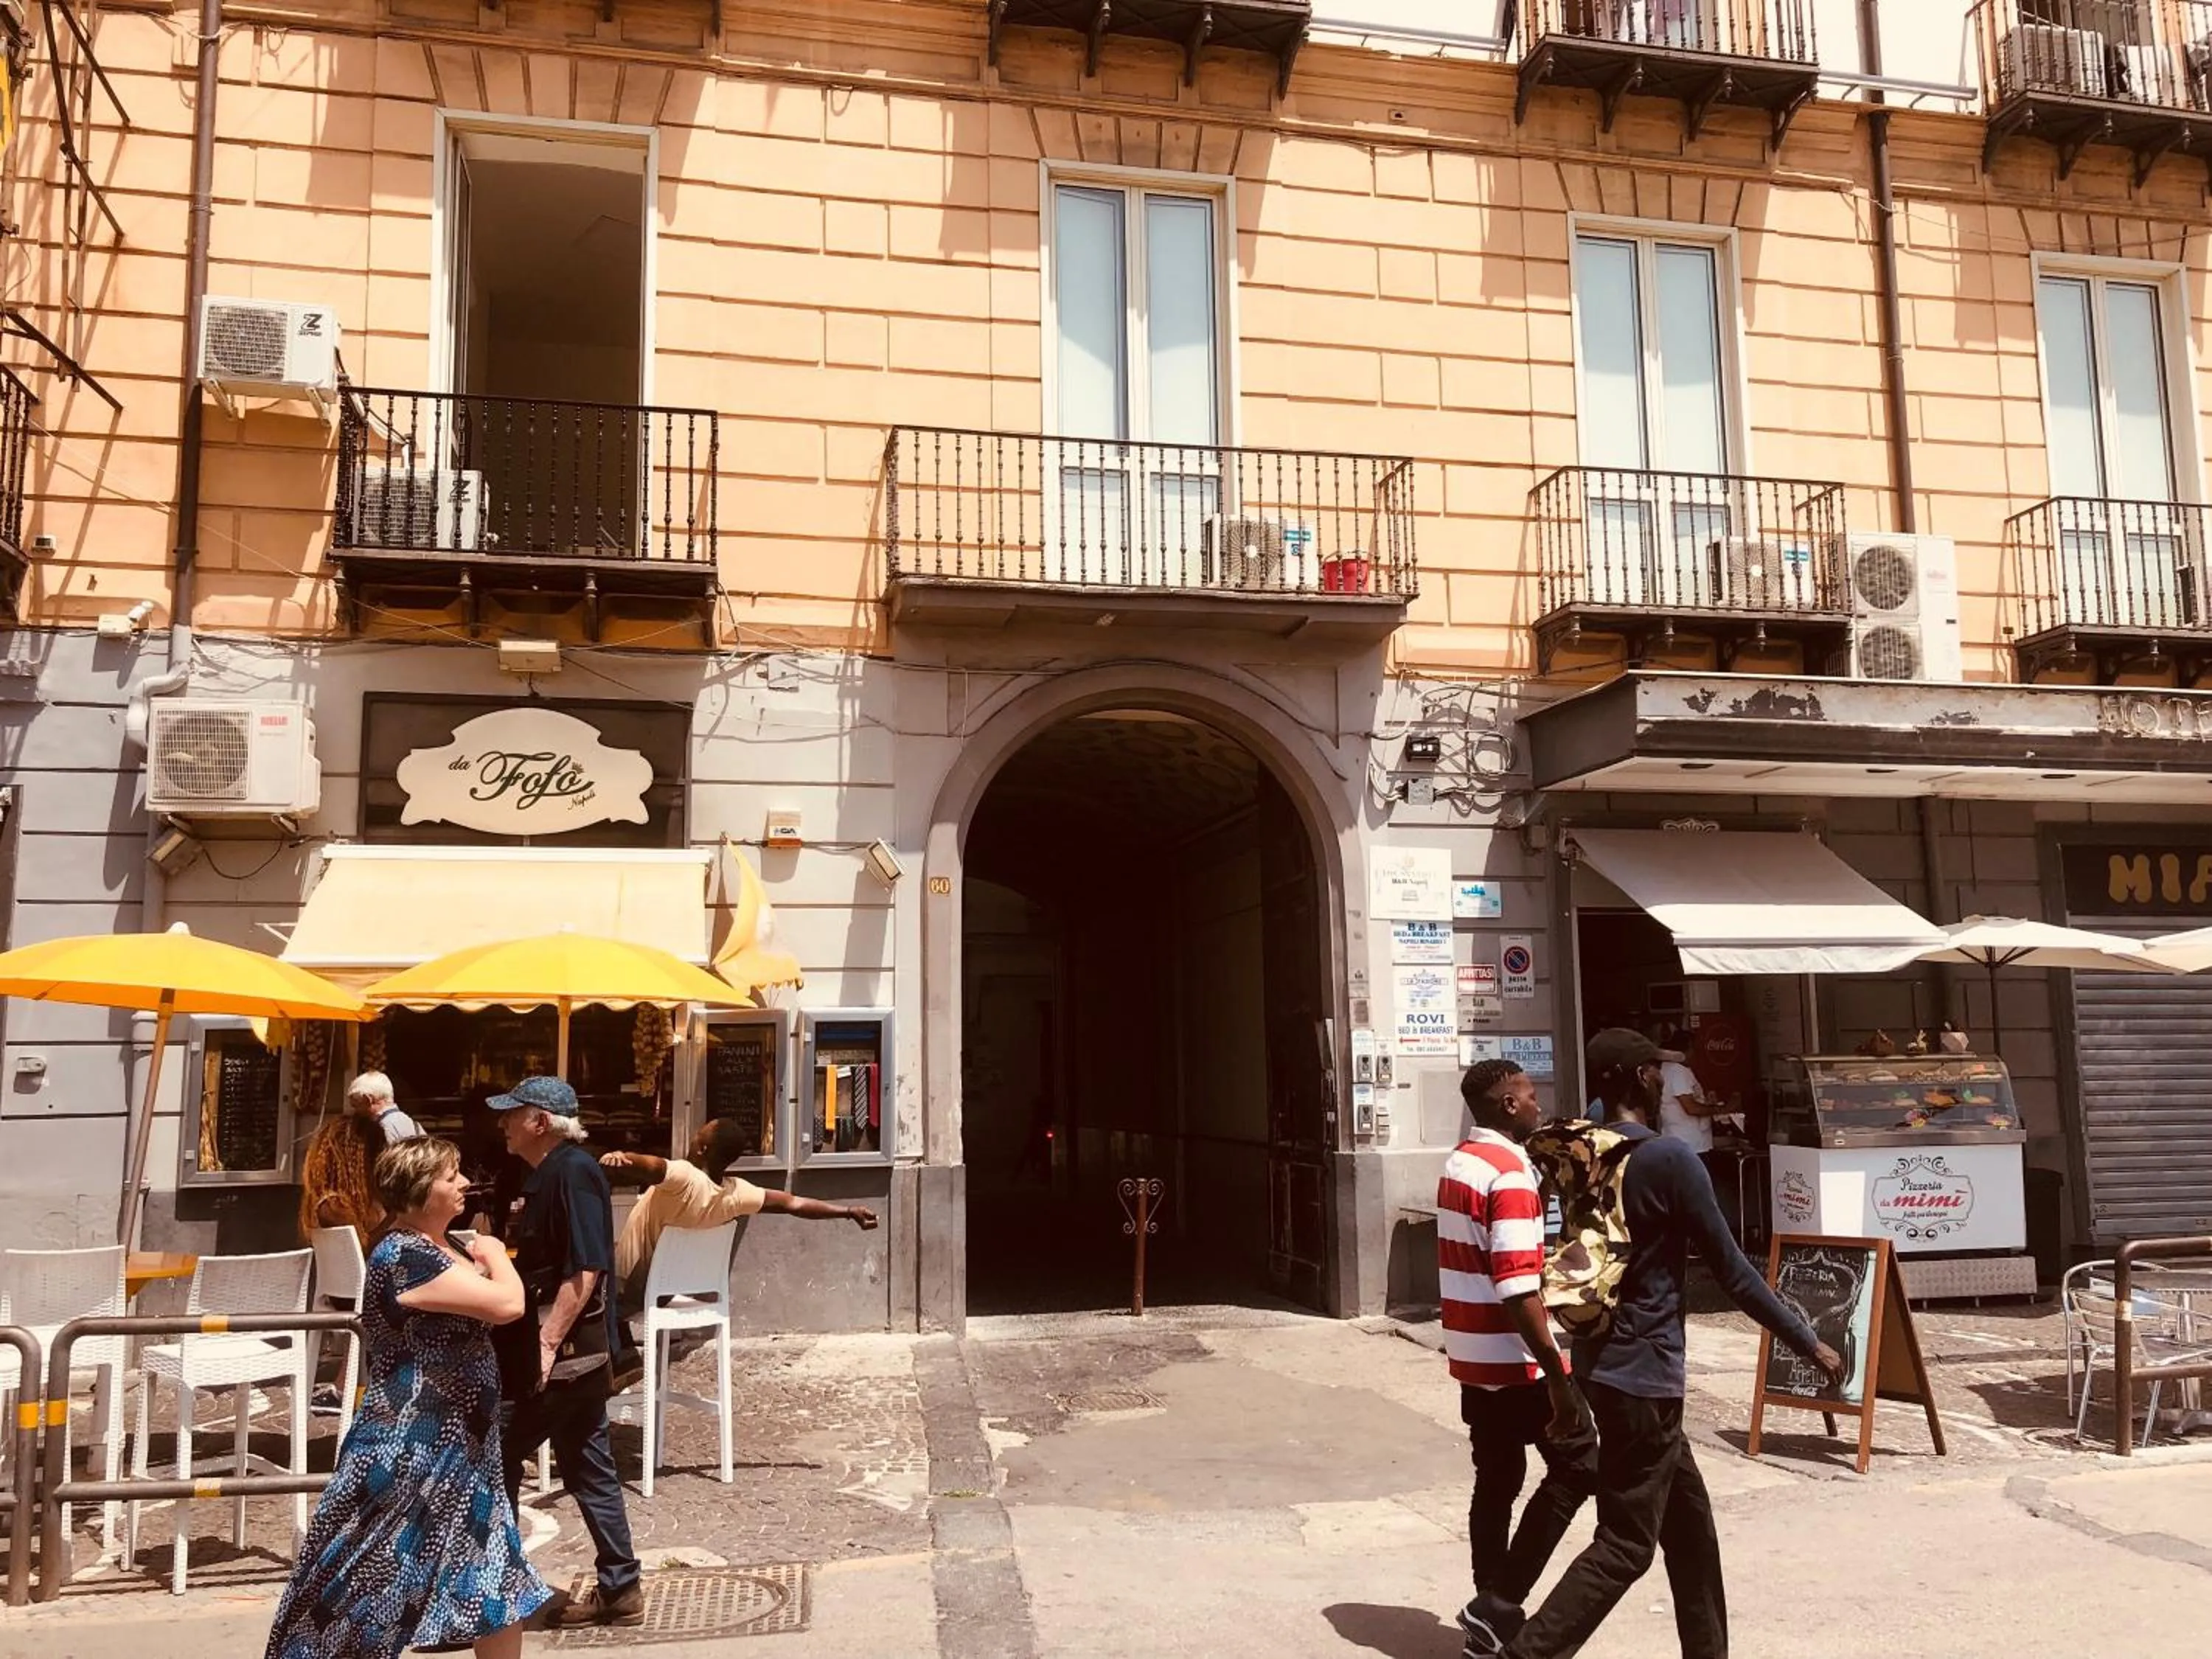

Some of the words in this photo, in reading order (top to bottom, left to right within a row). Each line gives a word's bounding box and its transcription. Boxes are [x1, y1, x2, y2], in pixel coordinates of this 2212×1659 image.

[448, 754, 470, 771] da
[931, 878, 949, 893] 60
[1406, 1014, 1445, 1024] ROVI
[1398, 1026, 1411, 1034] BED
[1419, 1026, 1454, 1034] BREAKFAST
[1512, 1037, 1543, 1051] B&B
[1900, 1178, 1943, 1191] Pizzeria
